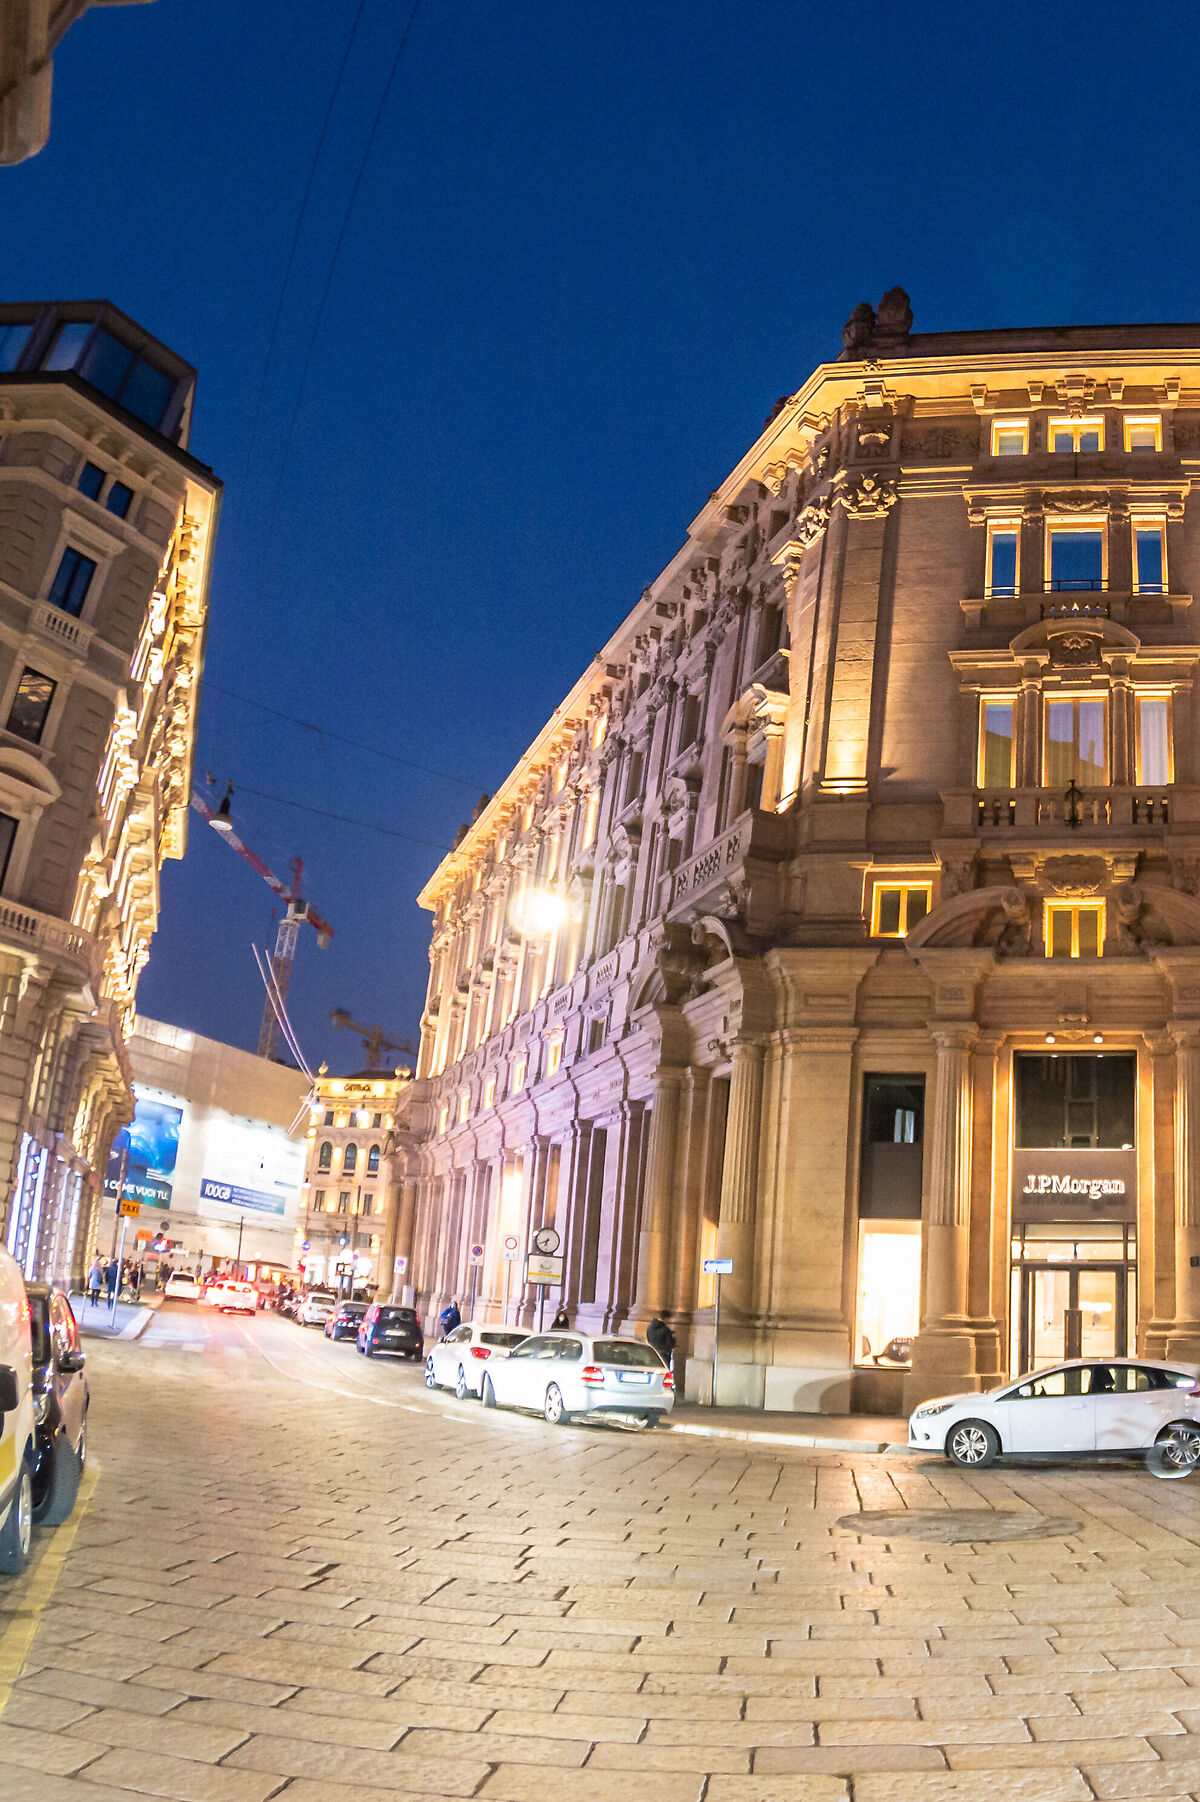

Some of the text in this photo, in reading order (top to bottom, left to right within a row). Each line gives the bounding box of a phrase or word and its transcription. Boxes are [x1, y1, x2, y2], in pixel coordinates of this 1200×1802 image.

[136, 1185, 156, 1197] VUOI
[204, 1183, 231, 1200] 100GB
[1023, 1175, 1125, 1199] J.P.Morgan
[122, 1203, 139, 1214] TAXI
